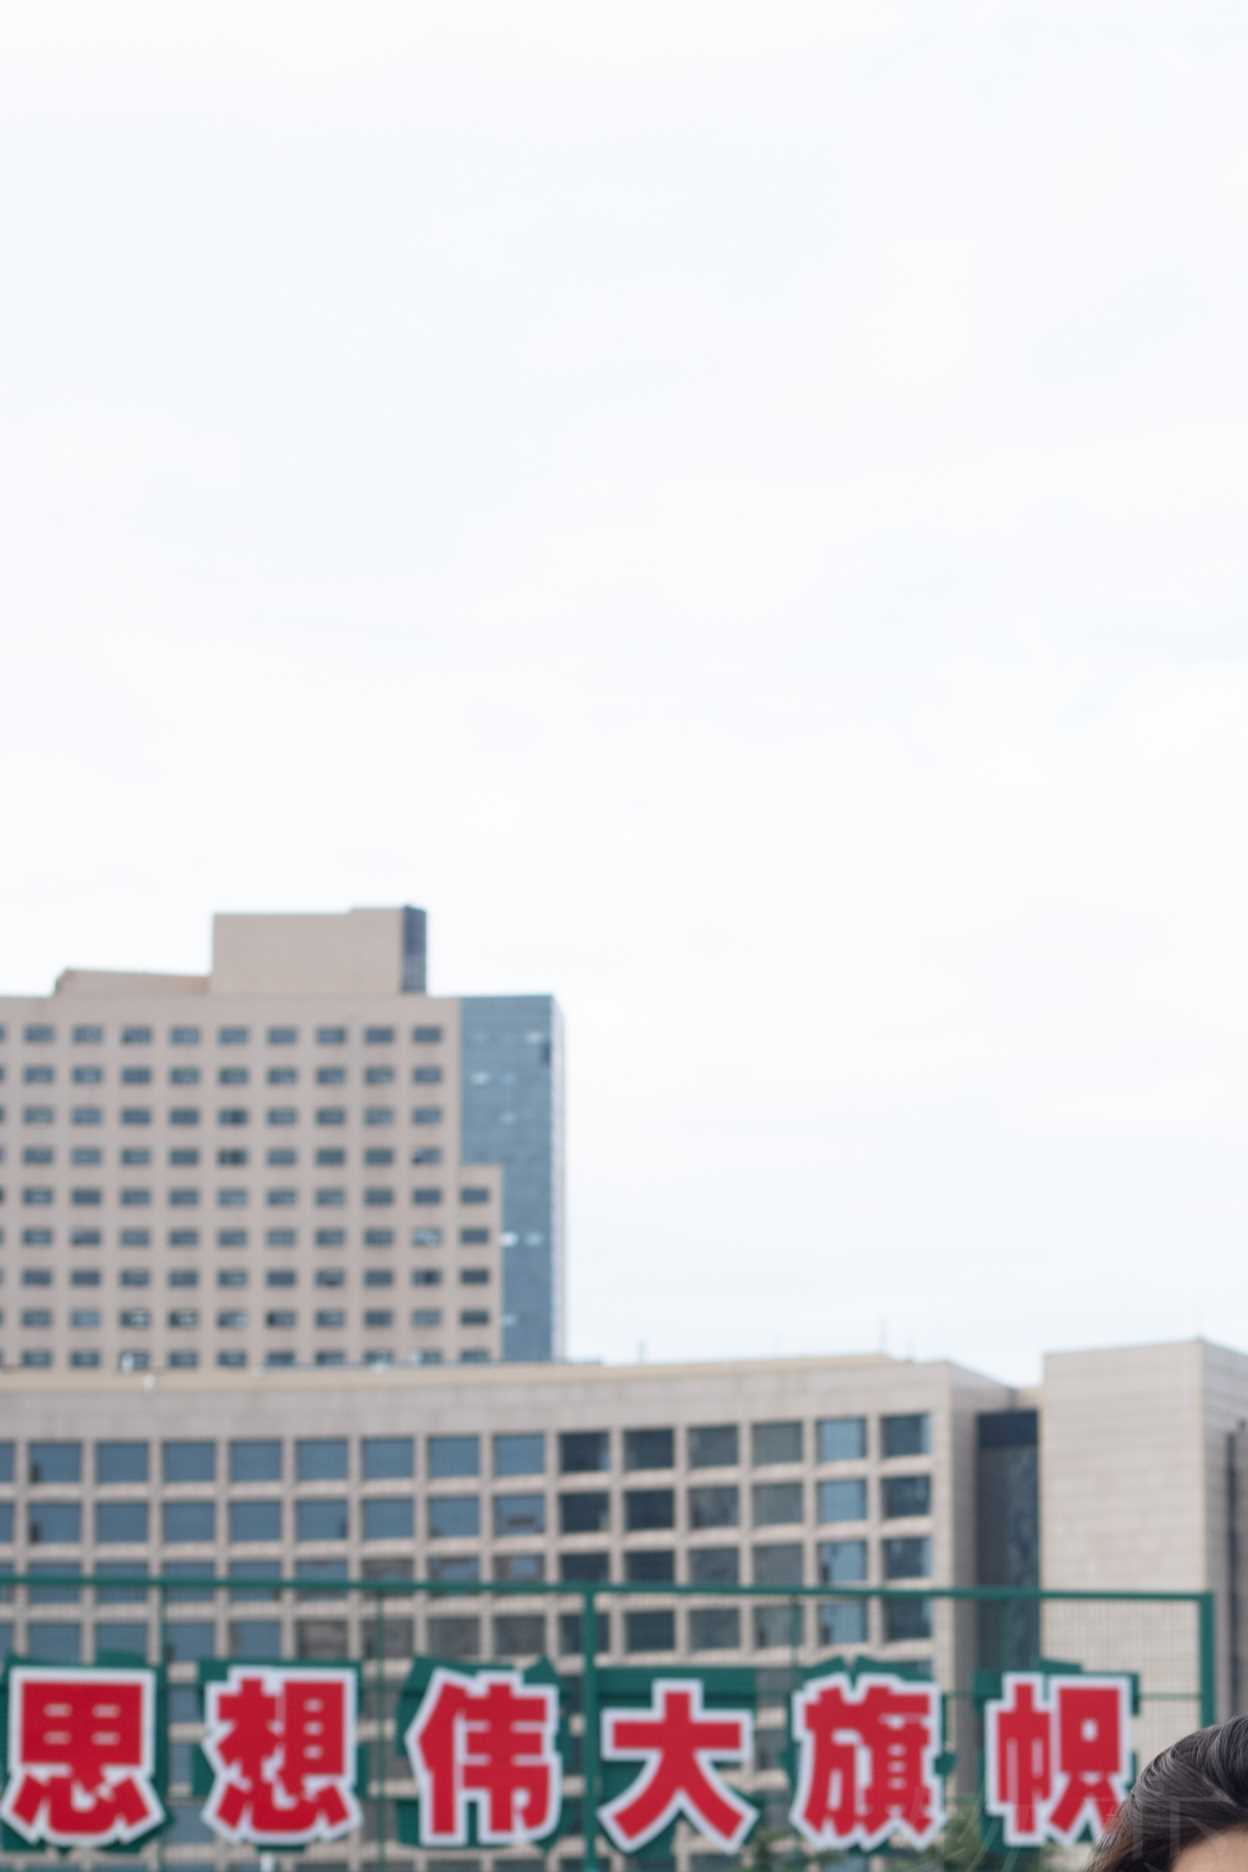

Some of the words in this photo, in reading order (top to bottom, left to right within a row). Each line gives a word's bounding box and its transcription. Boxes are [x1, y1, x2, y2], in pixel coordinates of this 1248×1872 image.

[2, 1666, 1134, 1853] 思想伟大旗帜
